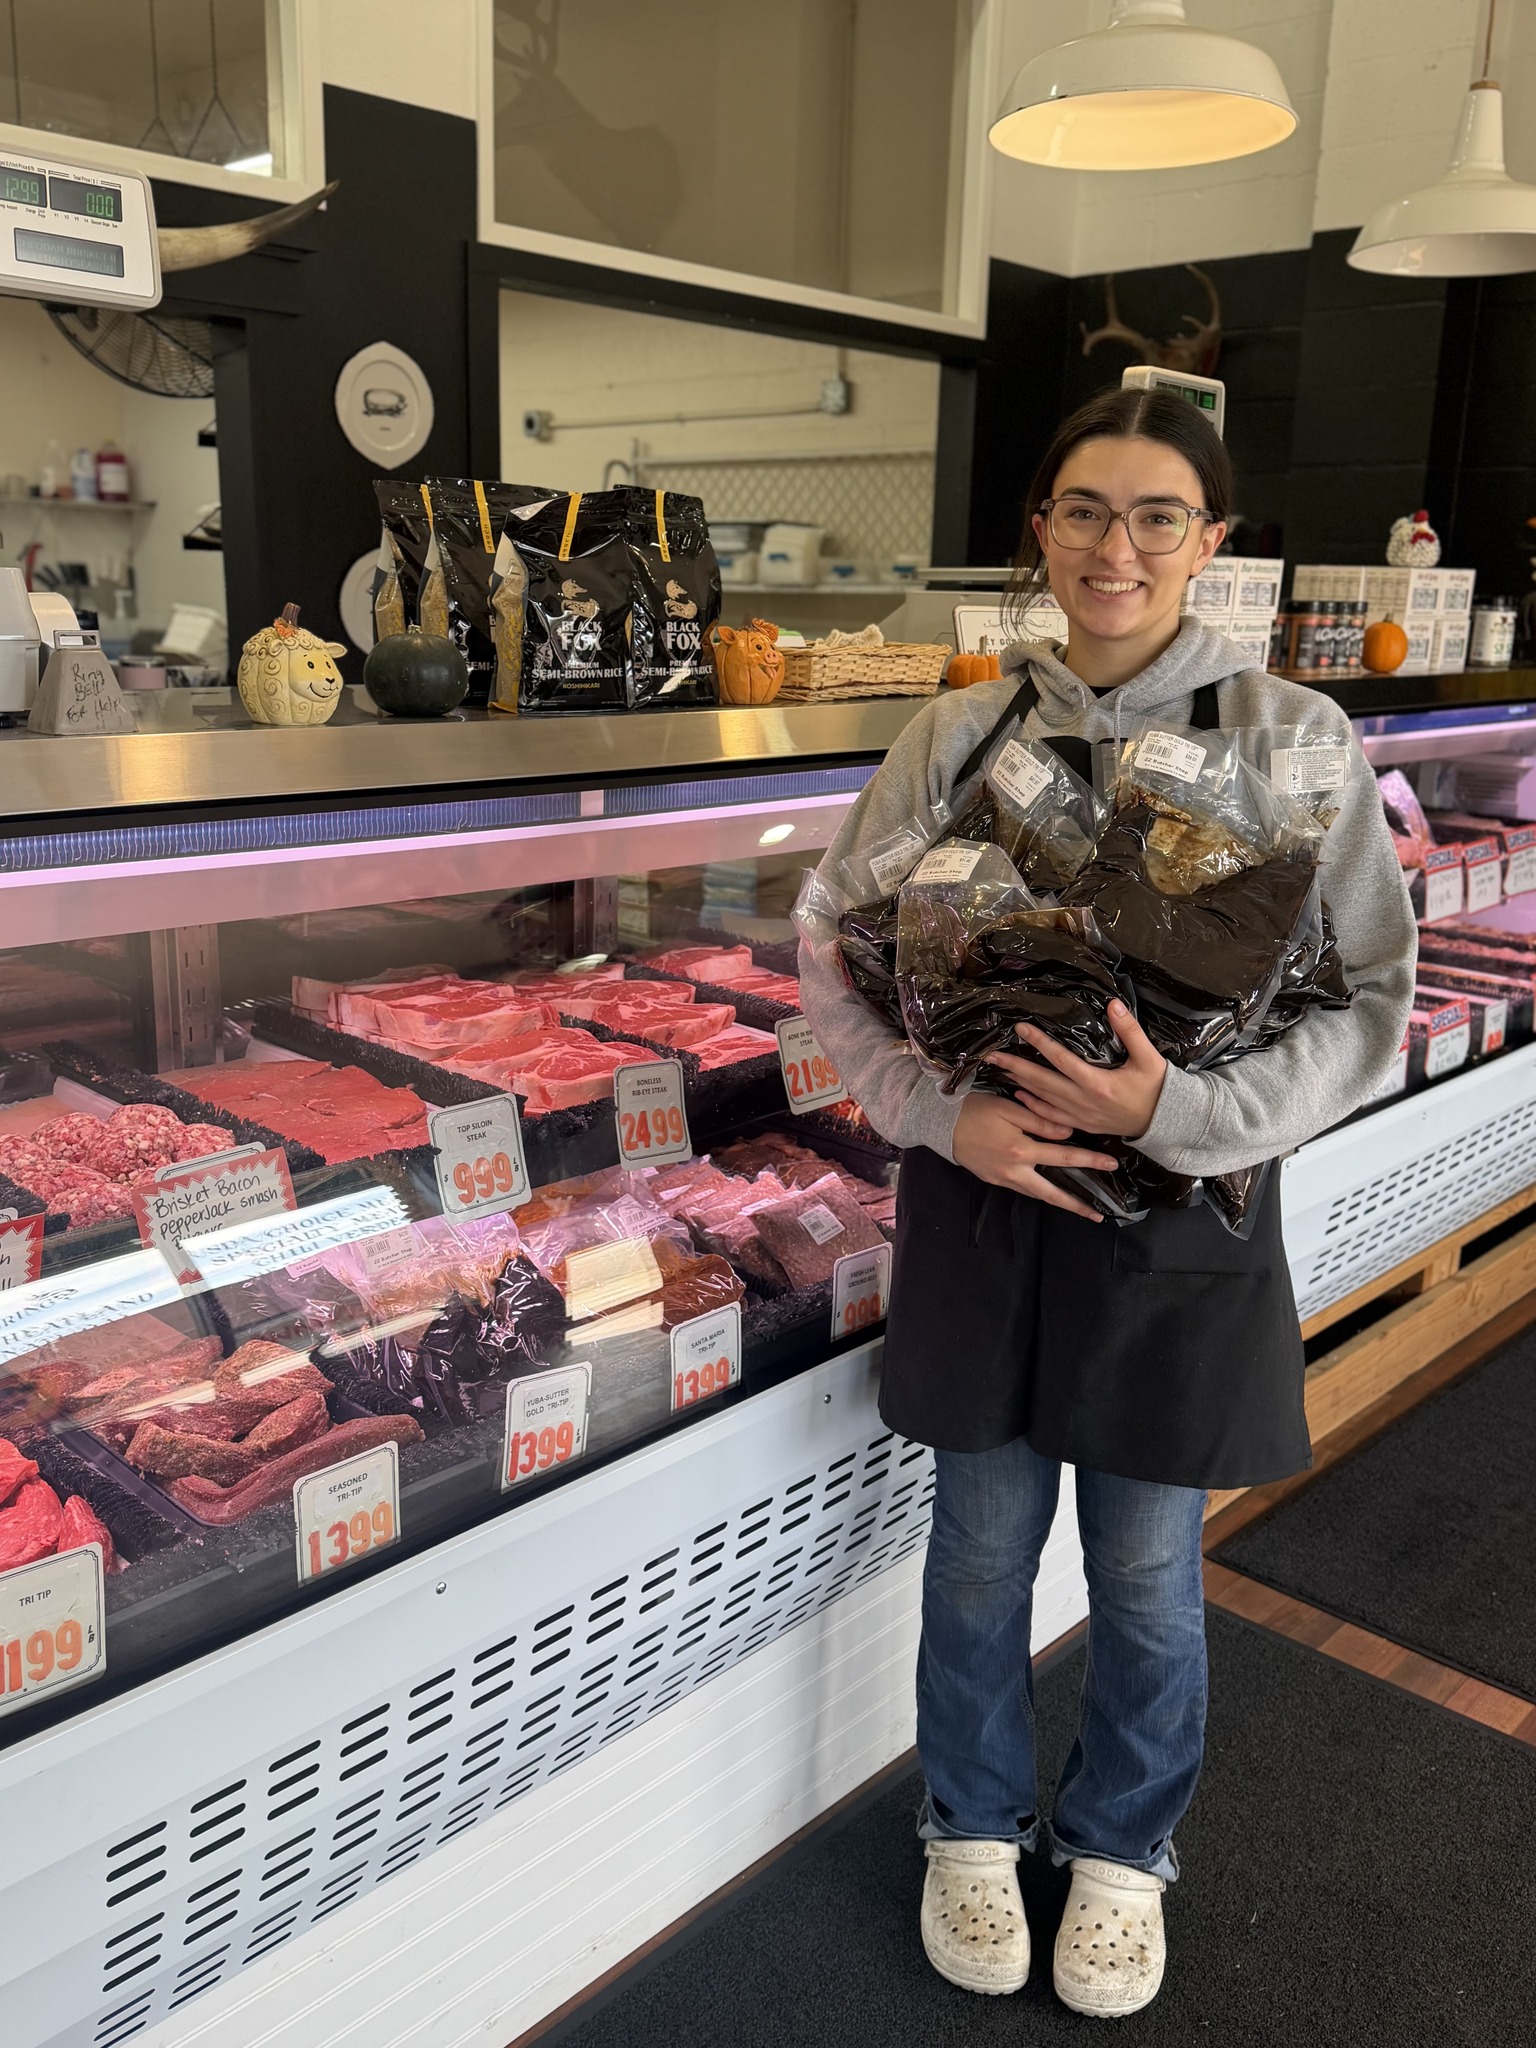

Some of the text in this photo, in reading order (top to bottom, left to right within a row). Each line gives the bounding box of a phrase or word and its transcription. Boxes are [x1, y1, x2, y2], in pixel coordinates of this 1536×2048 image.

[561, 620, 602, 632] BLACK
[666, 621, 700, 632] BLACK
[666, 632, 702, 650] FOX
[531, 667, 624, 680] SEMI-BROWN RICE
[1175, 766, 1189, 775] Shop
[1014, 786, 1026, 797] Shop
[799, 1038, 813, 1047] STEAK
[636, 1077, 662, 1086] BONELESS
[632, 1086, 668, 1097] RIB-EYE STEAK
[457, 1119, 493, 1133] TOP SILOIN
[466, 1131, 487, 1142] STEAK
[153, 1174, 261, 1219] Brisket Bacon
[240, 1187, 278, 1208] smash
[381, 1251, 400, 1262] Butcher
[400, 1246, 412, 1255] Shop
[691, 1328, 725, 1350] SANTA MARIA
[698, 1342, 716, 1354] TRI-TIP
[526, 1388, 570, 1407] YUBA-SUTTER
[526, 1397, 569, 1418] GOLD TRI-TIP
[328, 1472, 368, 1495] SEASONED
[337, 1486, 363, 1503] TRI-TIP
[18, 1589, 52, 1607] TRI TIP
